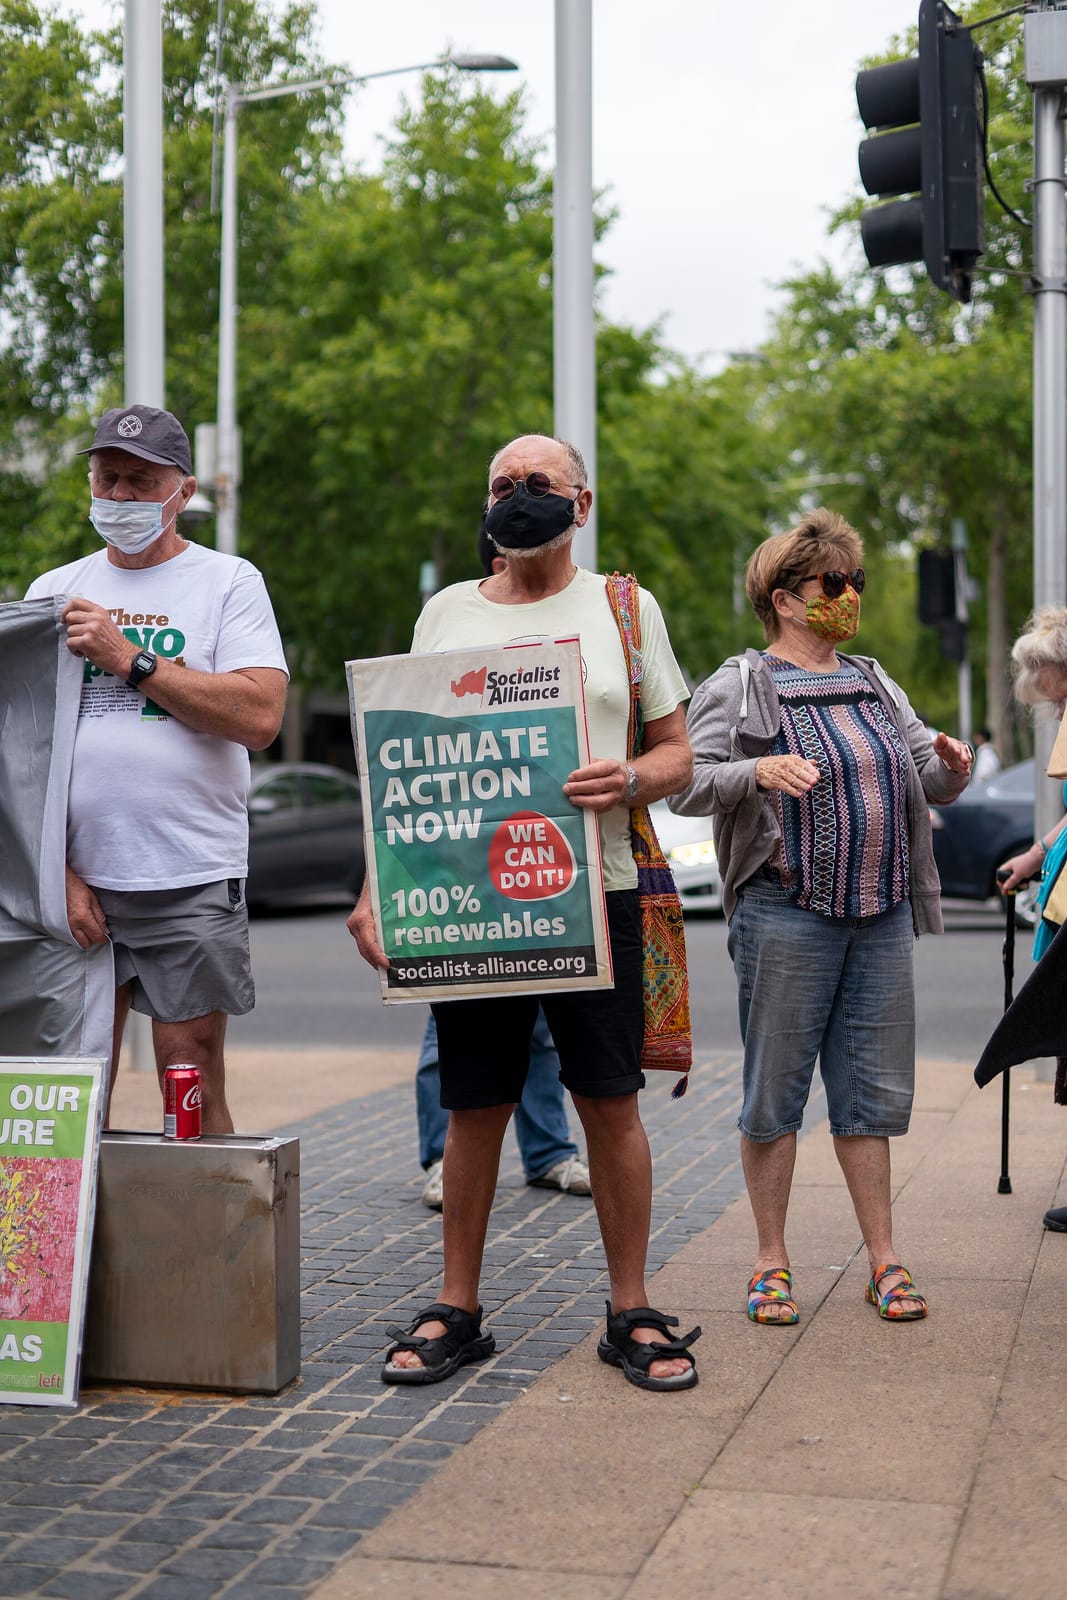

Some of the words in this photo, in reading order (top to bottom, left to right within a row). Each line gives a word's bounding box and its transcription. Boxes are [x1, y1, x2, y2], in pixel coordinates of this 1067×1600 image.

[122, 627, 186, 658] NO
[486, 666, 561, 690] Socialist
[488, 686, 560, 706] Alliance
[379, 725, 549, 770] CLIMATE
[382, 765, 531, 808] ACTION
[385, 807, 483, 846] NOW
[507, 822, 547, 844] WE
[504, 845, 555, 867] CAN
[500, 871, 531, 890] DO
[536, 869, 565, 887] IT!
[391, 884, 481, 919] 100%
[394, 911, 567, 947] renewables
[397, 956, 587, 981] socialist-alliance.org
[10, 1084, 81, 1112] OUR
[0, 1333, 42, 1363] AS
[39, 1373, 62, 1389] left
